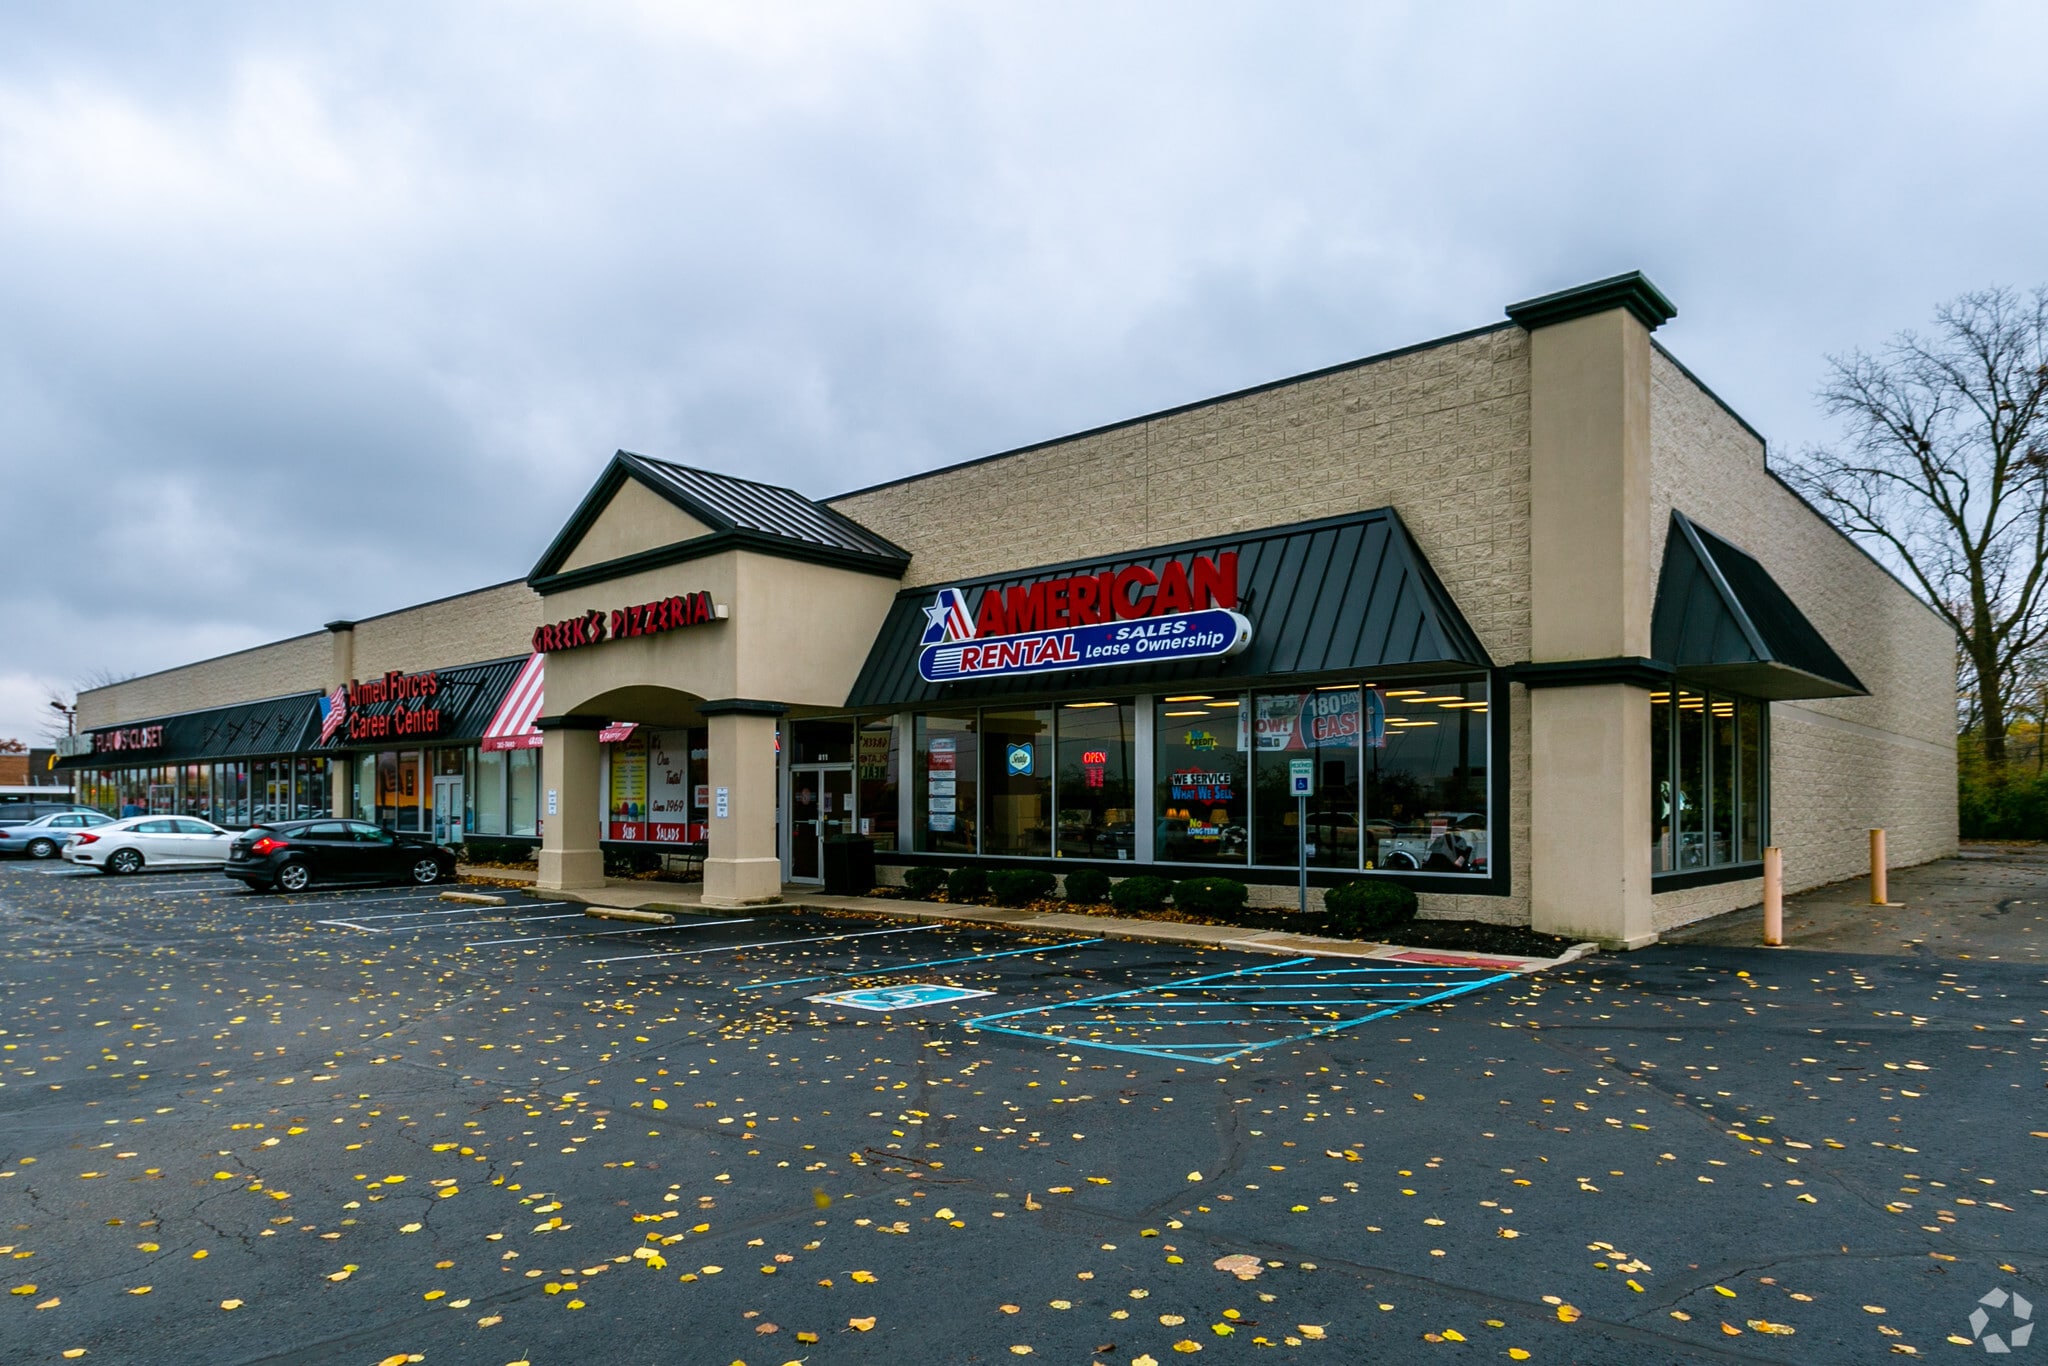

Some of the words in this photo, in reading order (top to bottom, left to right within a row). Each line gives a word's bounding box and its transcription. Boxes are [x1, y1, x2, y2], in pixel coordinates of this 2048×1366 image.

[975, 552, 1238, 639] AMERICAN
[532, 610, 606, 653] GREEK'S
[611, 591, 715, 639] PIZZERIA
[1115, 621, 1188, 641] SALES
[959, 634, 1080, 674] RENTAL
[1085, 641, 1131, 659] Lease
[1136, 631, 1224, 653] Ownership
[349, 672, 388, 706] Armed
[390, 671, 437, 699] Forces
[1309, 696, 1340, 717] 180
[350, 711, 391, 739] Career
[395, 704, 440, 735] Center
[1190, 737, 1214, 746] CREDIT
[1011, 753, 1028, 765] Sealy
[1083, 751, 1106, 764] OPEN
[1173, 774, 1188, 784] WE
[1191, 773, 1230, 784] SERVICE
[1172, 785, 1195, 799] WHAT
[1215, 785, 1233, 799] SELL
[666, 800, 684, 812] 1969
[656, 824, 680, 840] SALADS
